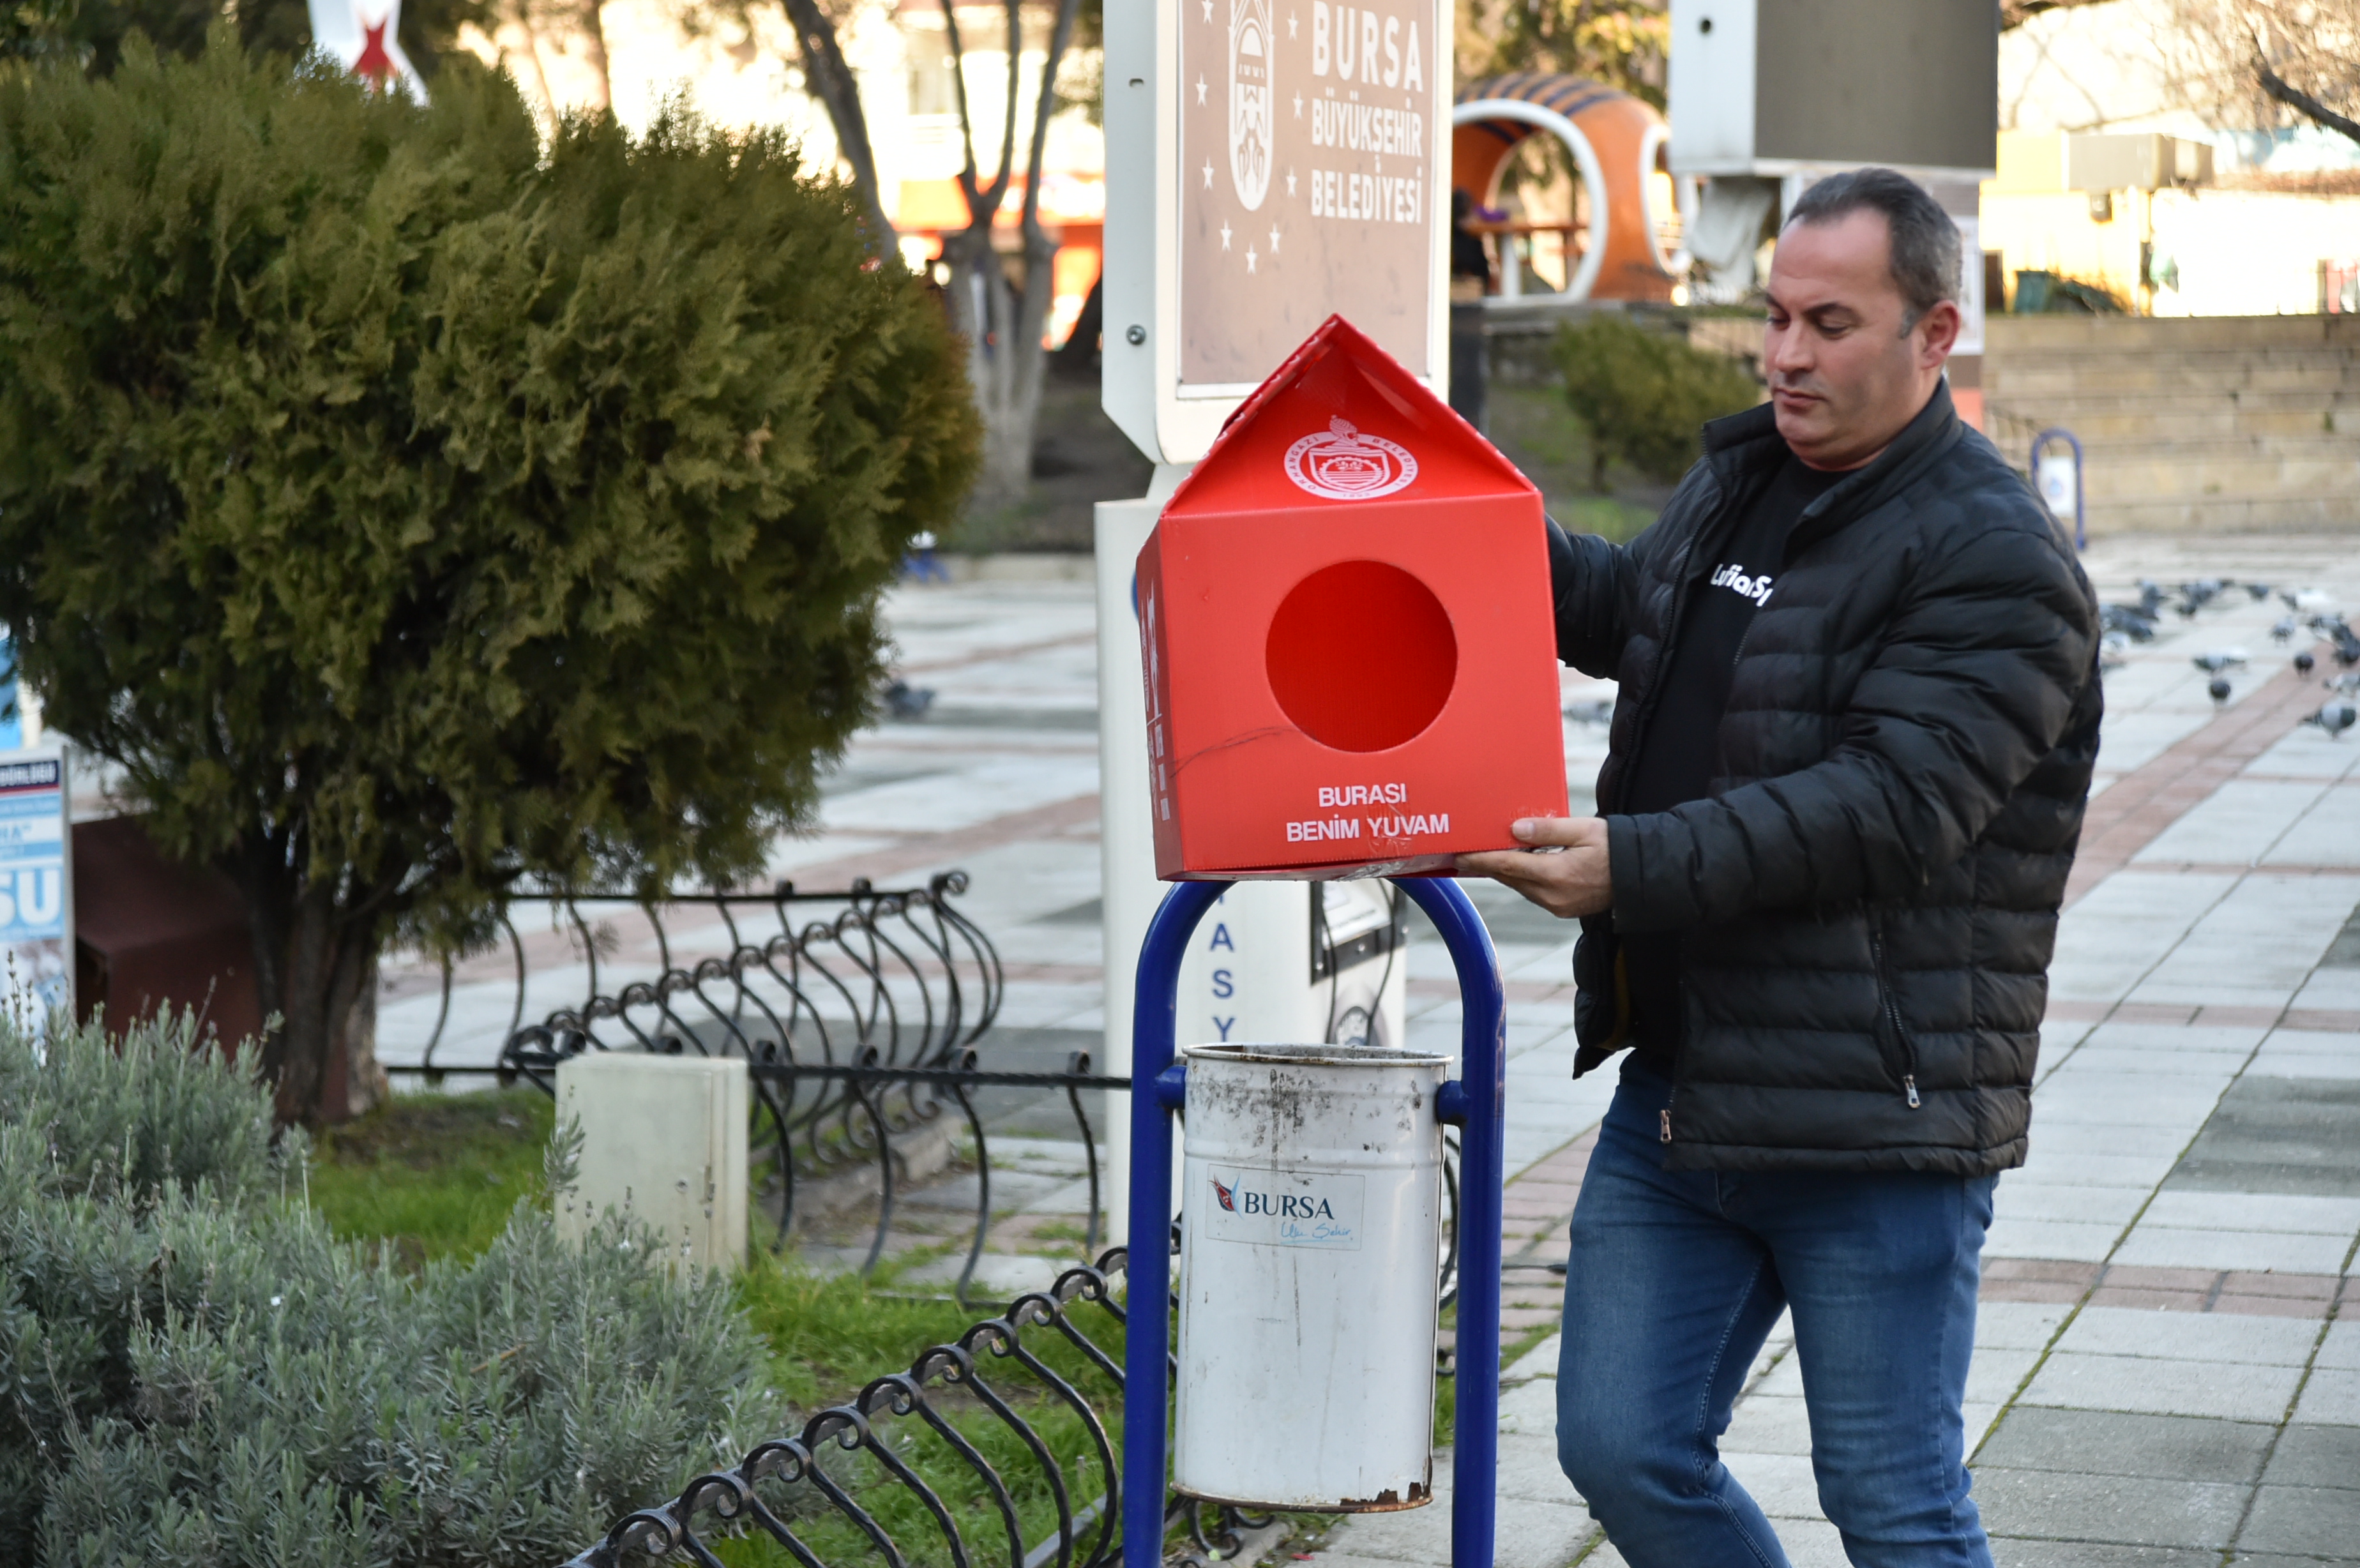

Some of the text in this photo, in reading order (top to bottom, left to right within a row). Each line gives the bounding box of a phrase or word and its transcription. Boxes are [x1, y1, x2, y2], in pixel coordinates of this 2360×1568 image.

[1312, 0, 1424, 93] BURSA
[1312, 87, 1423, 162] BÜYÜKŞEHİR
[1311, 165, 1422, 225] BELEDİYESİ
[1318, 783, 1407, 808] BURASI
[1286, 813, 1450, 842] BENİM YUVAM
[1244, 1192, 1336, 1220] BURSA
